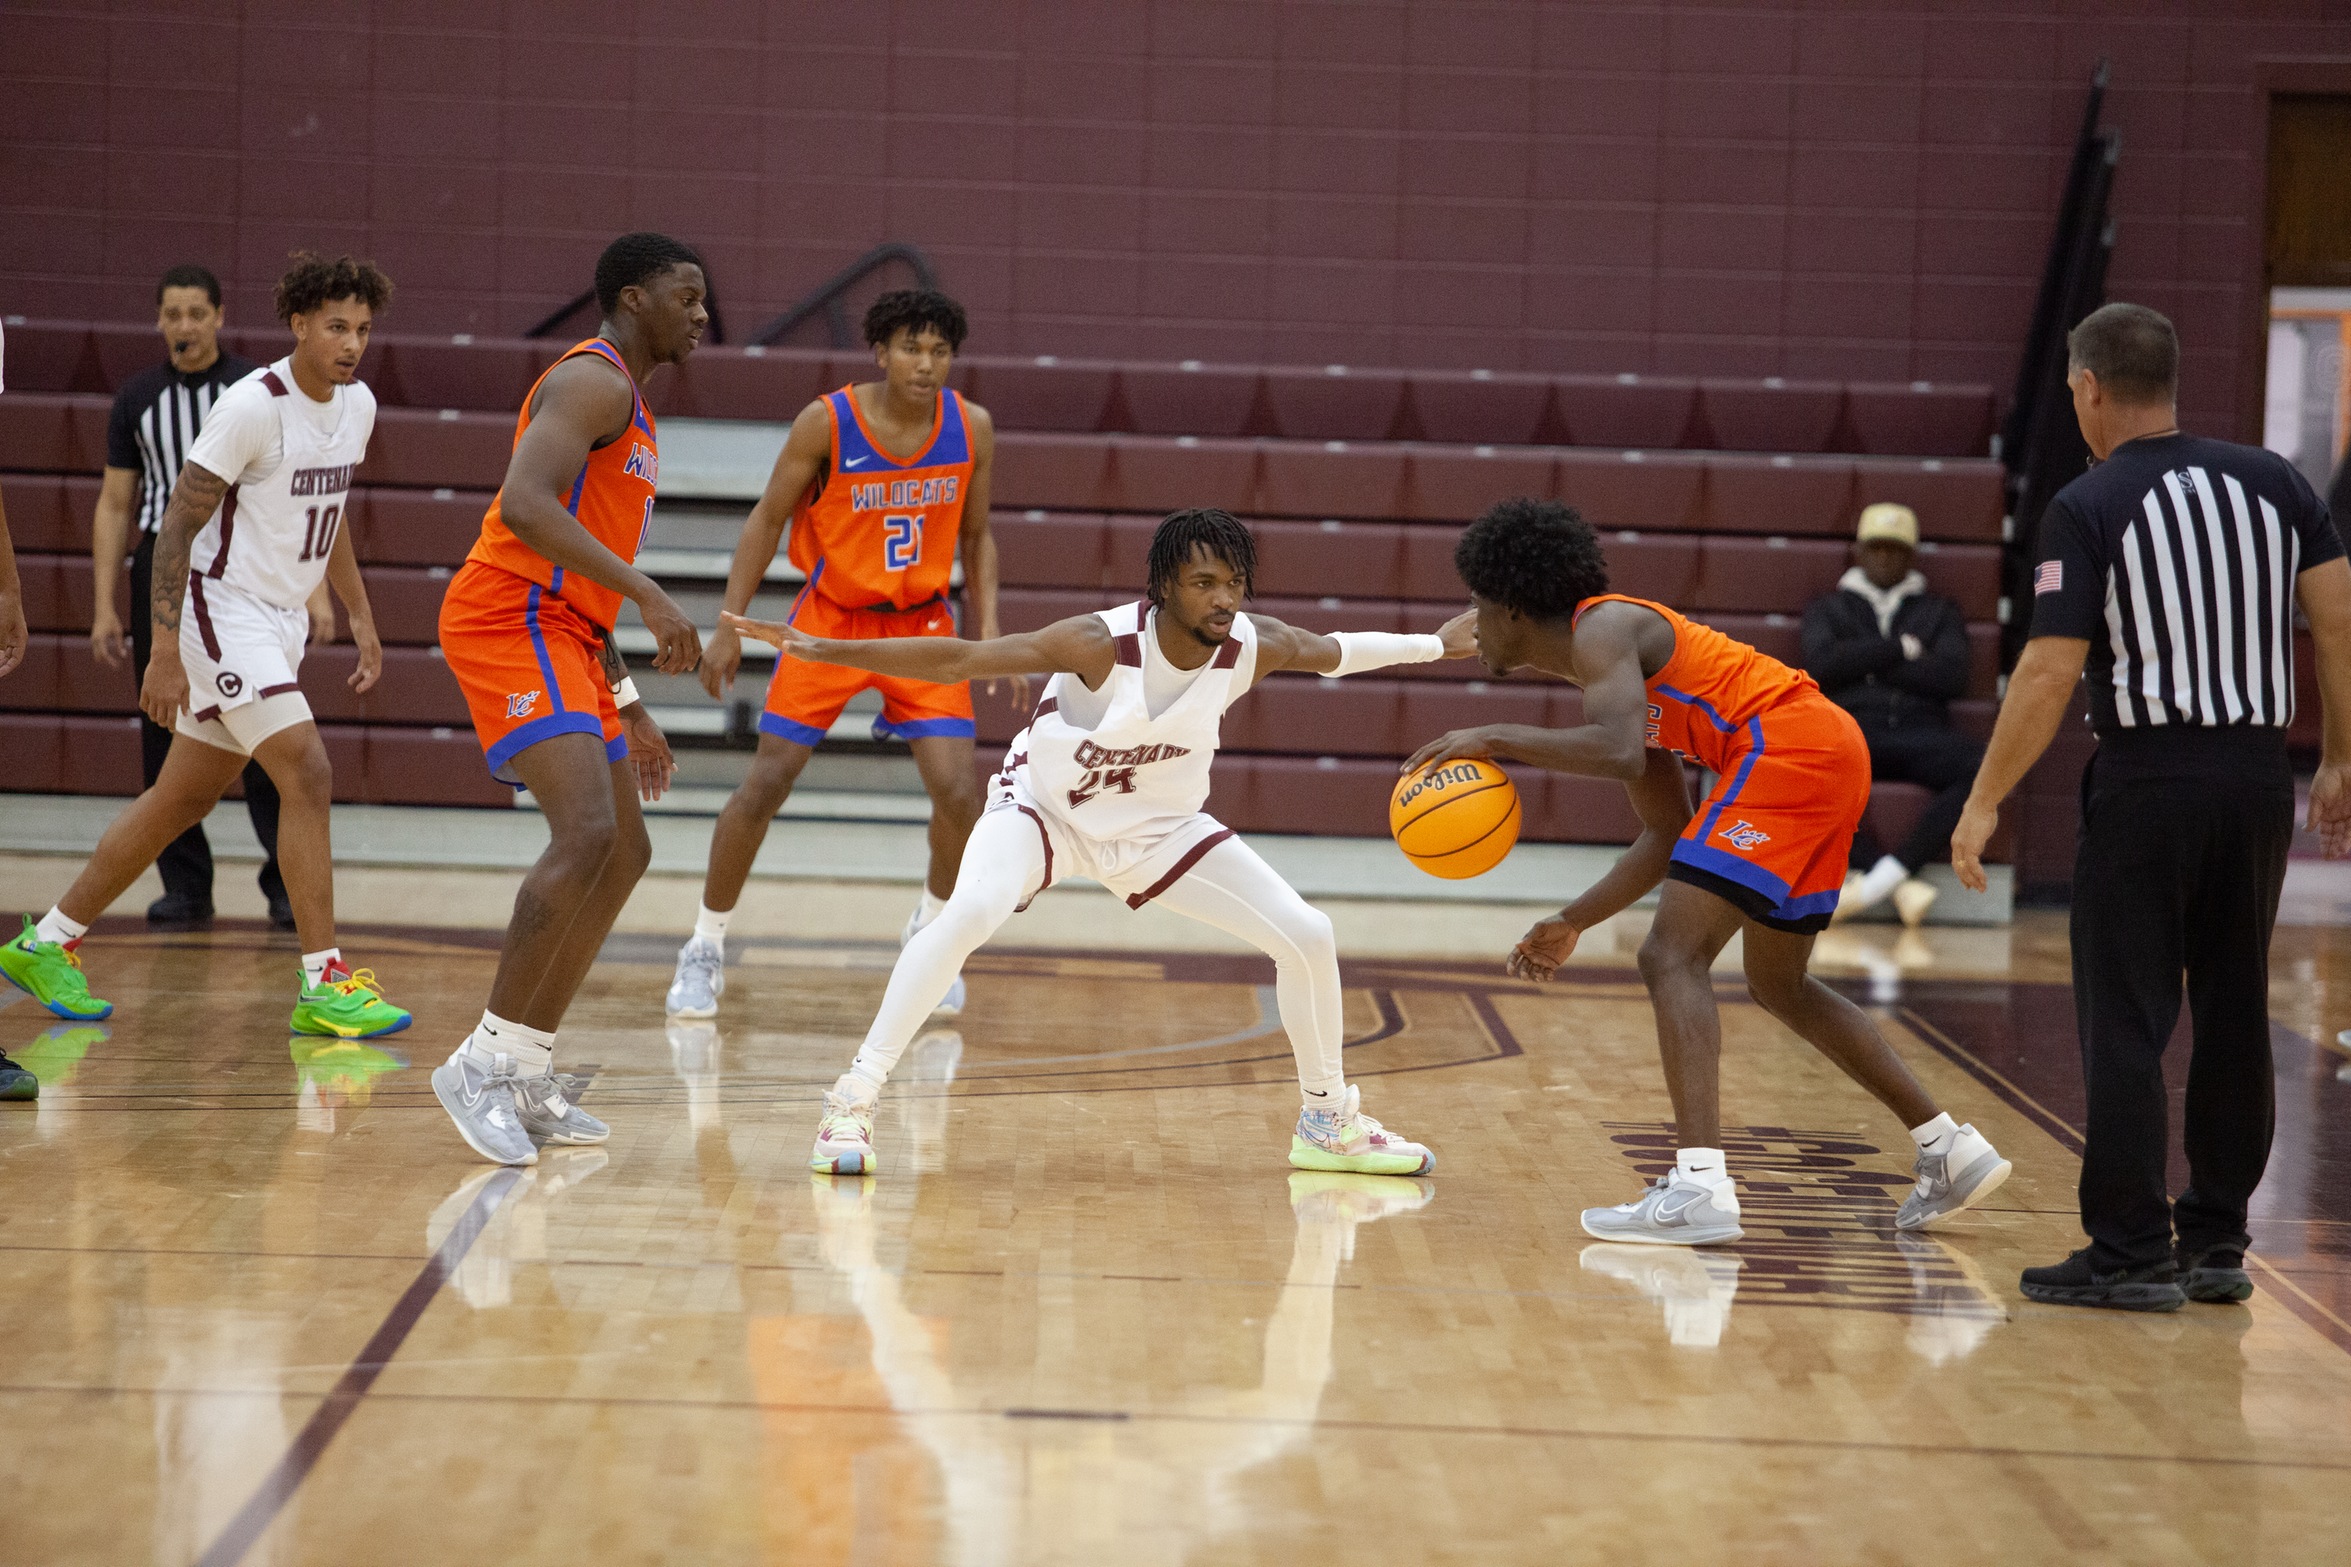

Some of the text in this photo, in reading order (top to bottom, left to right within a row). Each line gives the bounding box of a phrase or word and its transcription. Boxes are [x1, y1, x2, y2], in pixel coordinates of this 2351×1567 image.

[851, 475, 960, 513] WILDCATS
[298, 503, 339, 562] 10
[883, 513, 926, 572] 21
[1066, 766, 1137, 809] 24
[1399, 763, 1482, 808] Wilson
